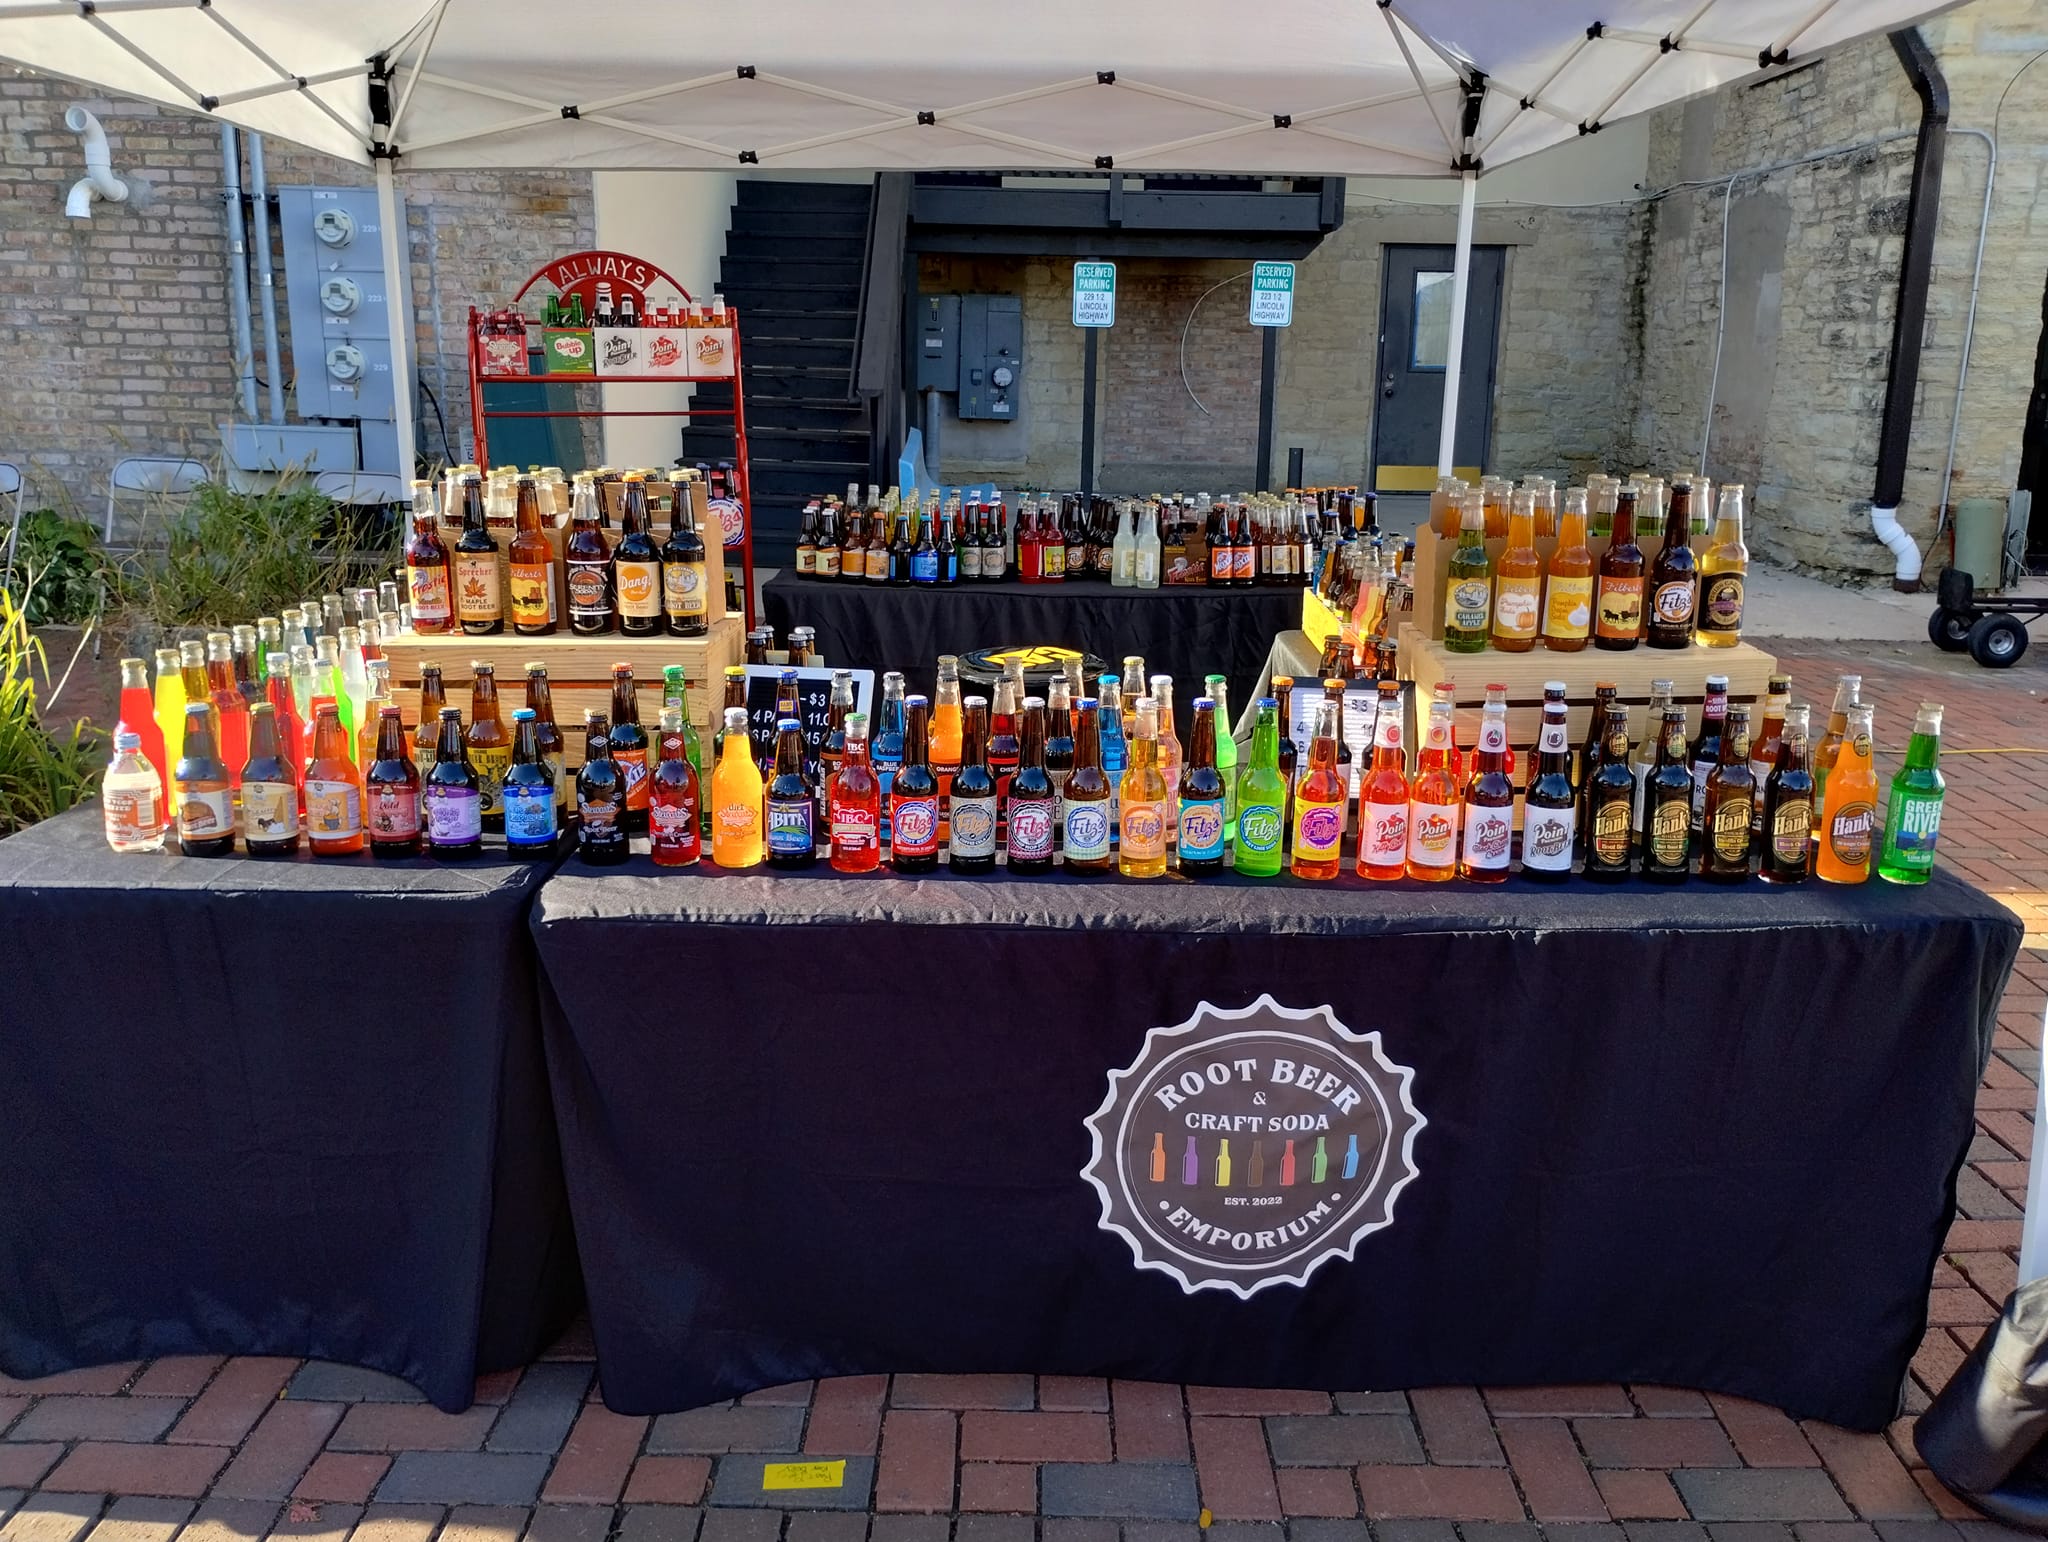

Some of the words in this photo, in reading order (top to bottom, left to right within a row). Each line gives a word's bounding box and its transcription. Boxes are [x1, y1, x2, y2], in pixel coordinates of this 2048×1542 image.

[558, 257, 646, 285] ALWAYS
[1077, 266, 1113, 278] RESERVED
[1256, 265, 1292, 277] RESERVED
[1079, 278, 1110, 290] PARKING
[1257, 277, 1289, 290] PARKING
[1080, 302, 1108, 311] LINCOLN
[1256, 302, 1285, 310] LINCOLN
[1079, 311, 1109, 320] HIGHWAY
[1255, 311, 1285, 320] HIGHWAY
[555, 341, 582, 350] Bubble
[568, 346, 583, 355] up
[603, 339, 632, 357] Point
[650, 339, 678, 357] Point
[696, 339, 724, 357] Point
[458, 567, 493, 576] Sprecher
[411, 574, 447, 600] Frostie
[620, 575, 652, 590] Dang!
[1659, 592, 1693, 613] Fitz's
[809, 692, 826, 707] $3
[752, 709, 761, 723] 4
[1296, 721, 1305, 734] 4
[847, 743, 866, 751] IBC
[1298, 741, 1305, 754] 6
[767, 811, 807, 830] ABITA
[840, 814, 864, 824] IBC
[899, 812, 934, 834] Fitz's
[957, 813, 991, 836] Fitz's
[1013, 815, 1051, 839] Fitz's
[1069, 816, 1104, 837] Fitz's
[1126, 816, 1161, 839] Fitz's
[1184, 815, 1220, 836] Fitz's
[1833, 811, 1875, 836] Hank's
[1243, 816, 1281, 841] Fitz's
[1375, 819, 1406, 840] Poin
[1417, 817, 1454, 841] Point
[1475, 819, 1511, 843] Point
[1533, 821, 1571, 844] Point
[1154, 1059, 1257, 1112] ROOT
[1270, 1059, 1362, 1116] BEER
[1253, 1091, 1267, 1106] &
[1185, 1112, 1263, 1133] CRAFT
[1268, 1114, 1330, 1133] SODA
[1224, 1196, 1250, 1206] EST.
[1252, 1196, 1283, 1206] 2022
[1164, 1200, 1332, 1251] EMPORIUM
